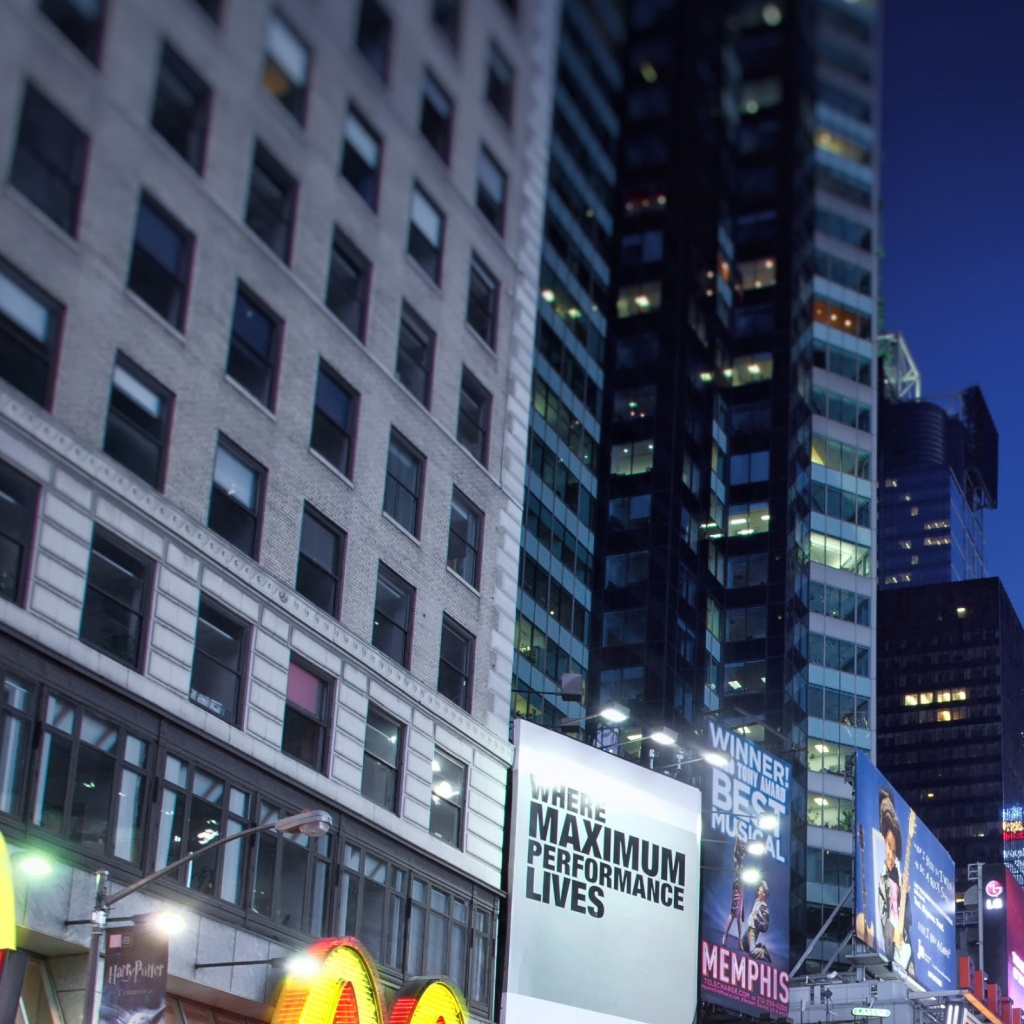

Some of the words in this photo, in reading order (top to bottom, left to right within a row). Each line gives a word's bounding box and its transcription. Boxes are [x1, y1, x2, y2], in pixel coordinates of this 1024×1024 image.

[709, 722, 789, 788] WINNER!
[737, 761, 759, 788] TONY
[760, 775, 786, 803] AWARD
[530, 773, 606, 823] WHERE
[712, 767, 786, 839] BEST
[529, 801, 685, 886] MAXIMUM
[712, 807, 785, 863] MUSICAL
[526, 866, 605, 919] LIVES
[527, 839, 684, 911] PERFORMANCE
[108, 964, 134, 985] Harry
[133, 960, 165, 984] Potter
[702, 939, 789, 1004] MEMPHIS
